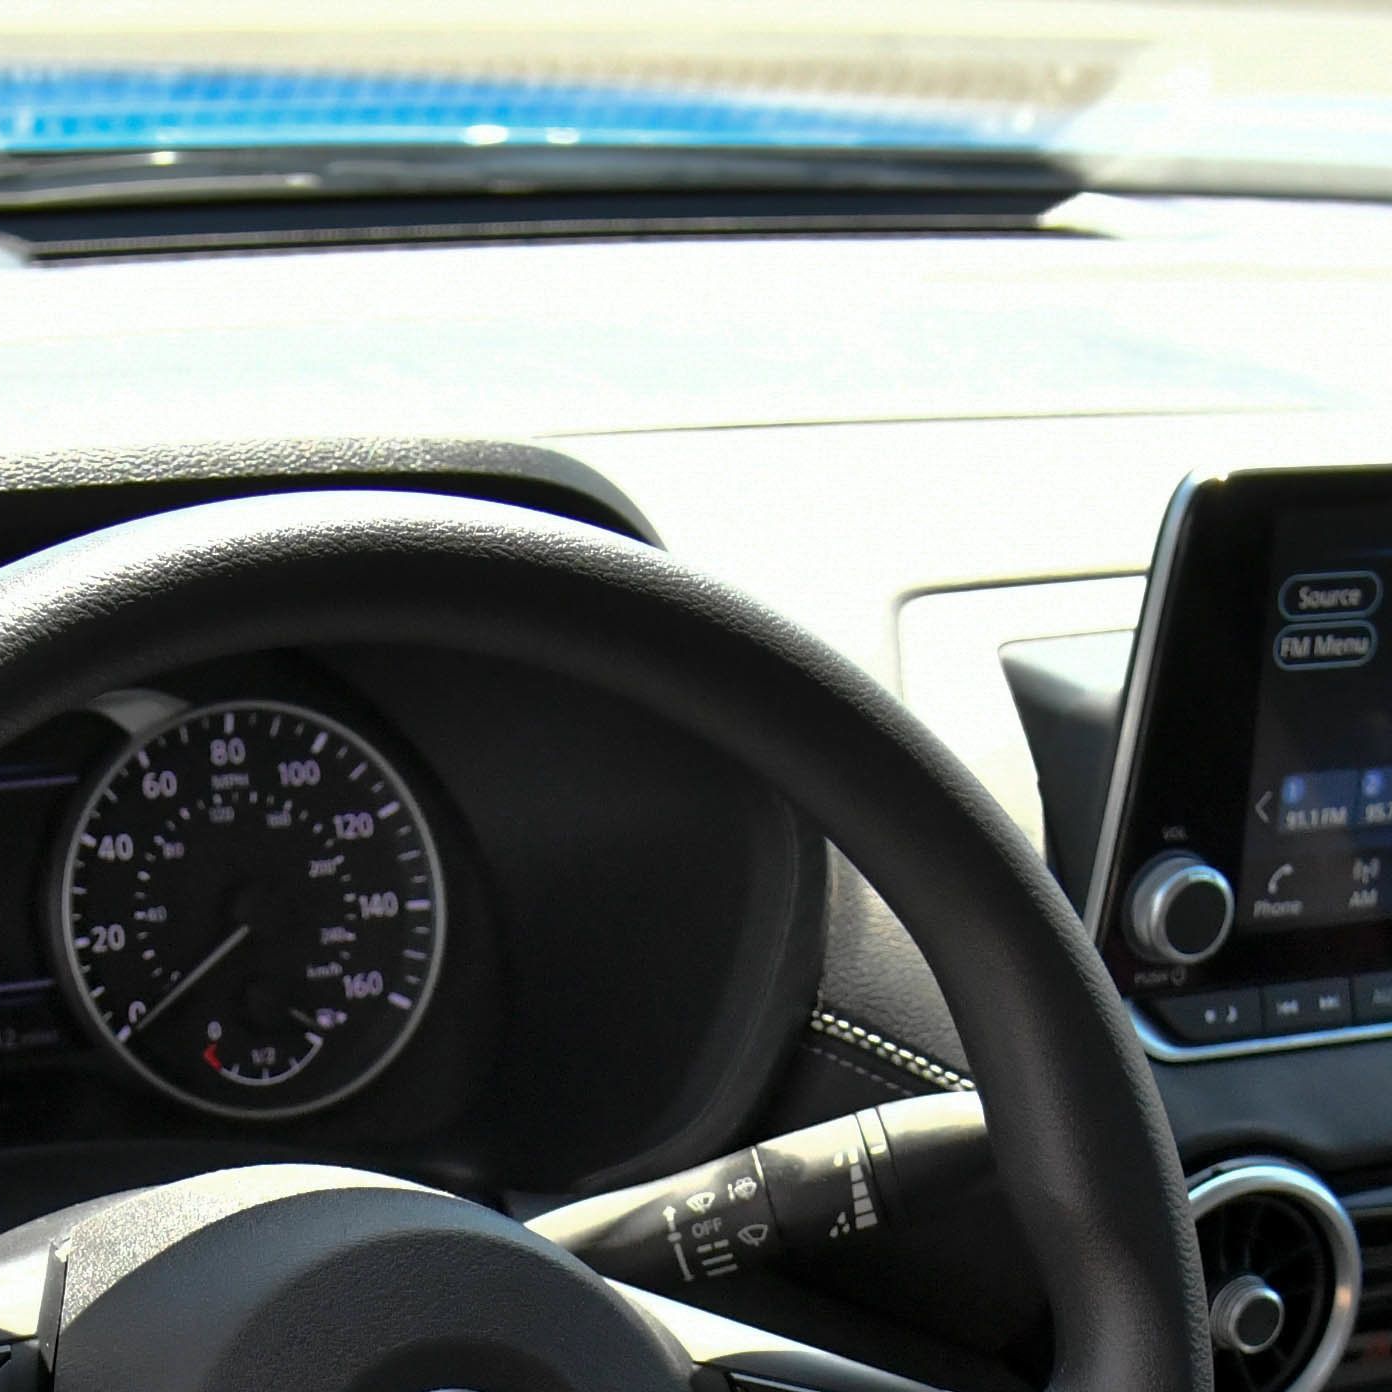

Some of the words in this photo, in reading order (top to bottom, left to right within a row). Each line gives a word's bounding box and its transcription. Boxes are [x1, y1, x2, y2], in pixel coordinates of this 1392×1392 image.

[1298, 586, 1363, 610] Source
[1280, 636, 1310, 659] FM
[1314, 634, 1369, 657] Menu
[210, 737, 246, 766] 80
[142, 770, 178, 799] 60
[278, 759, 321, 787] 100
[333, 812, 375, 841] 120
[97, 833, 135, 862] 40
[358, 891, 400, 919] 140
[1253, 899, 1305, 918] Phone
[1348, 889, 1379, 908] AM
[92, 924, 126, 954] 20
[343, 970, 383, 999] 160
[691, 1217, 723, 1239] OFF
